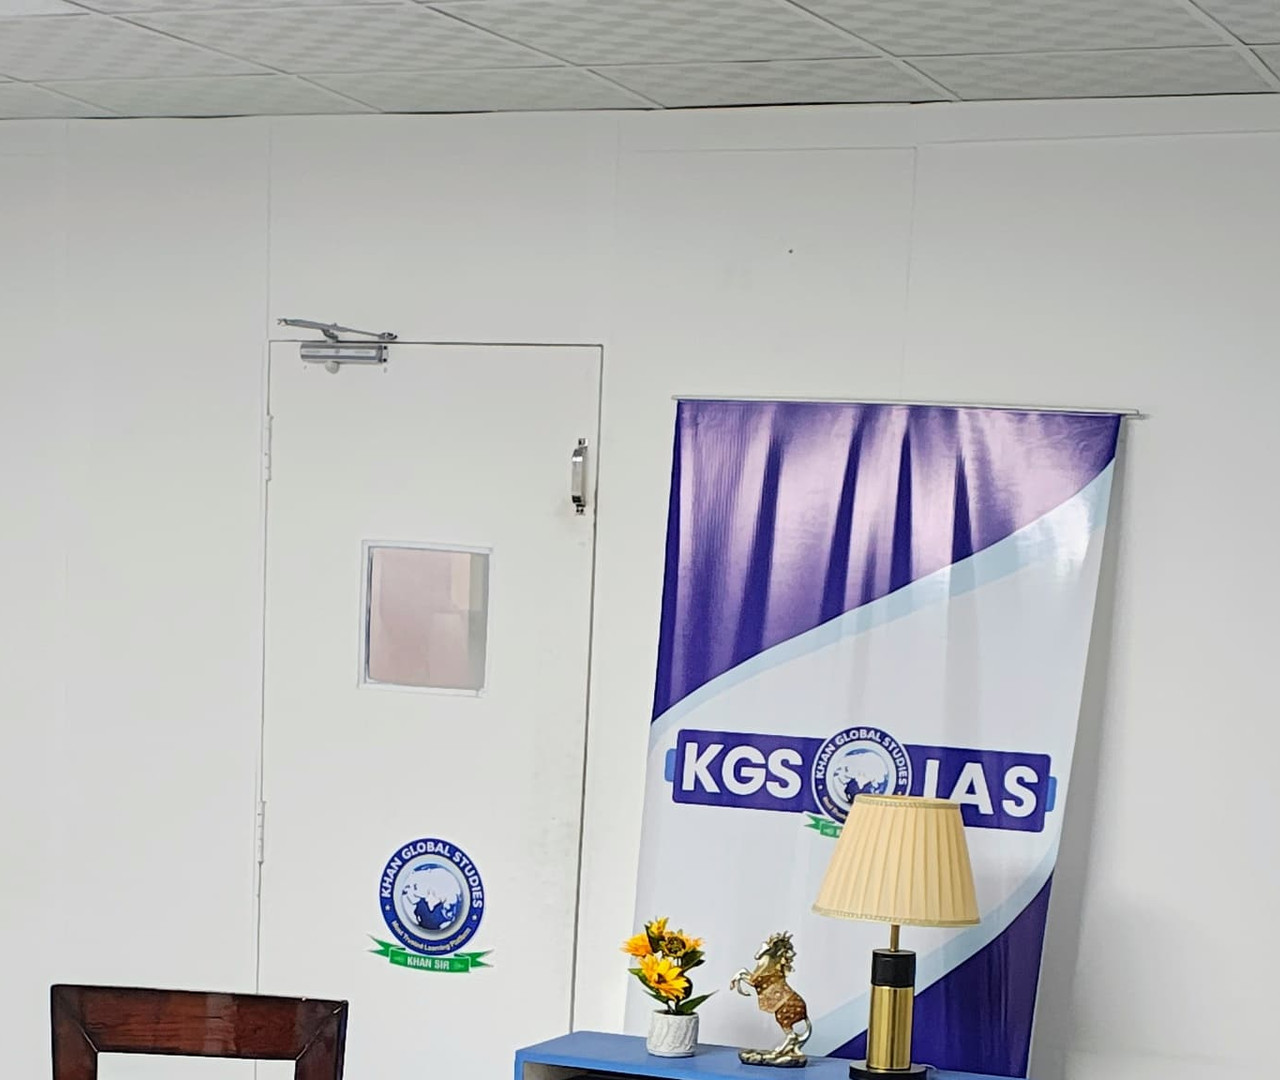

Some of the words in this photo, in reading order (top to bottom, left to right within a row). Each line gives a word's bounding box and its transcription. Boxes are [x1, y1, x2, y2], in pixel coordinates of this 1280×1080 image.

[681, 742, 803, 800] KGS
[924, 758, 1041, 818] IAS
[815, 743, 836, 780] KHAN
[835, 729, 882, 745] GLOBAL
[882, 738, 908, 786] STUDIES
[381, 857, 402, 898] KHAN
[402, 841, 450, 859] GLOBAL
[452, 851, 483, 909] STUDIES
[407, 956, 432, 969] KHAN
[434, 959, 450, 970] SIR
